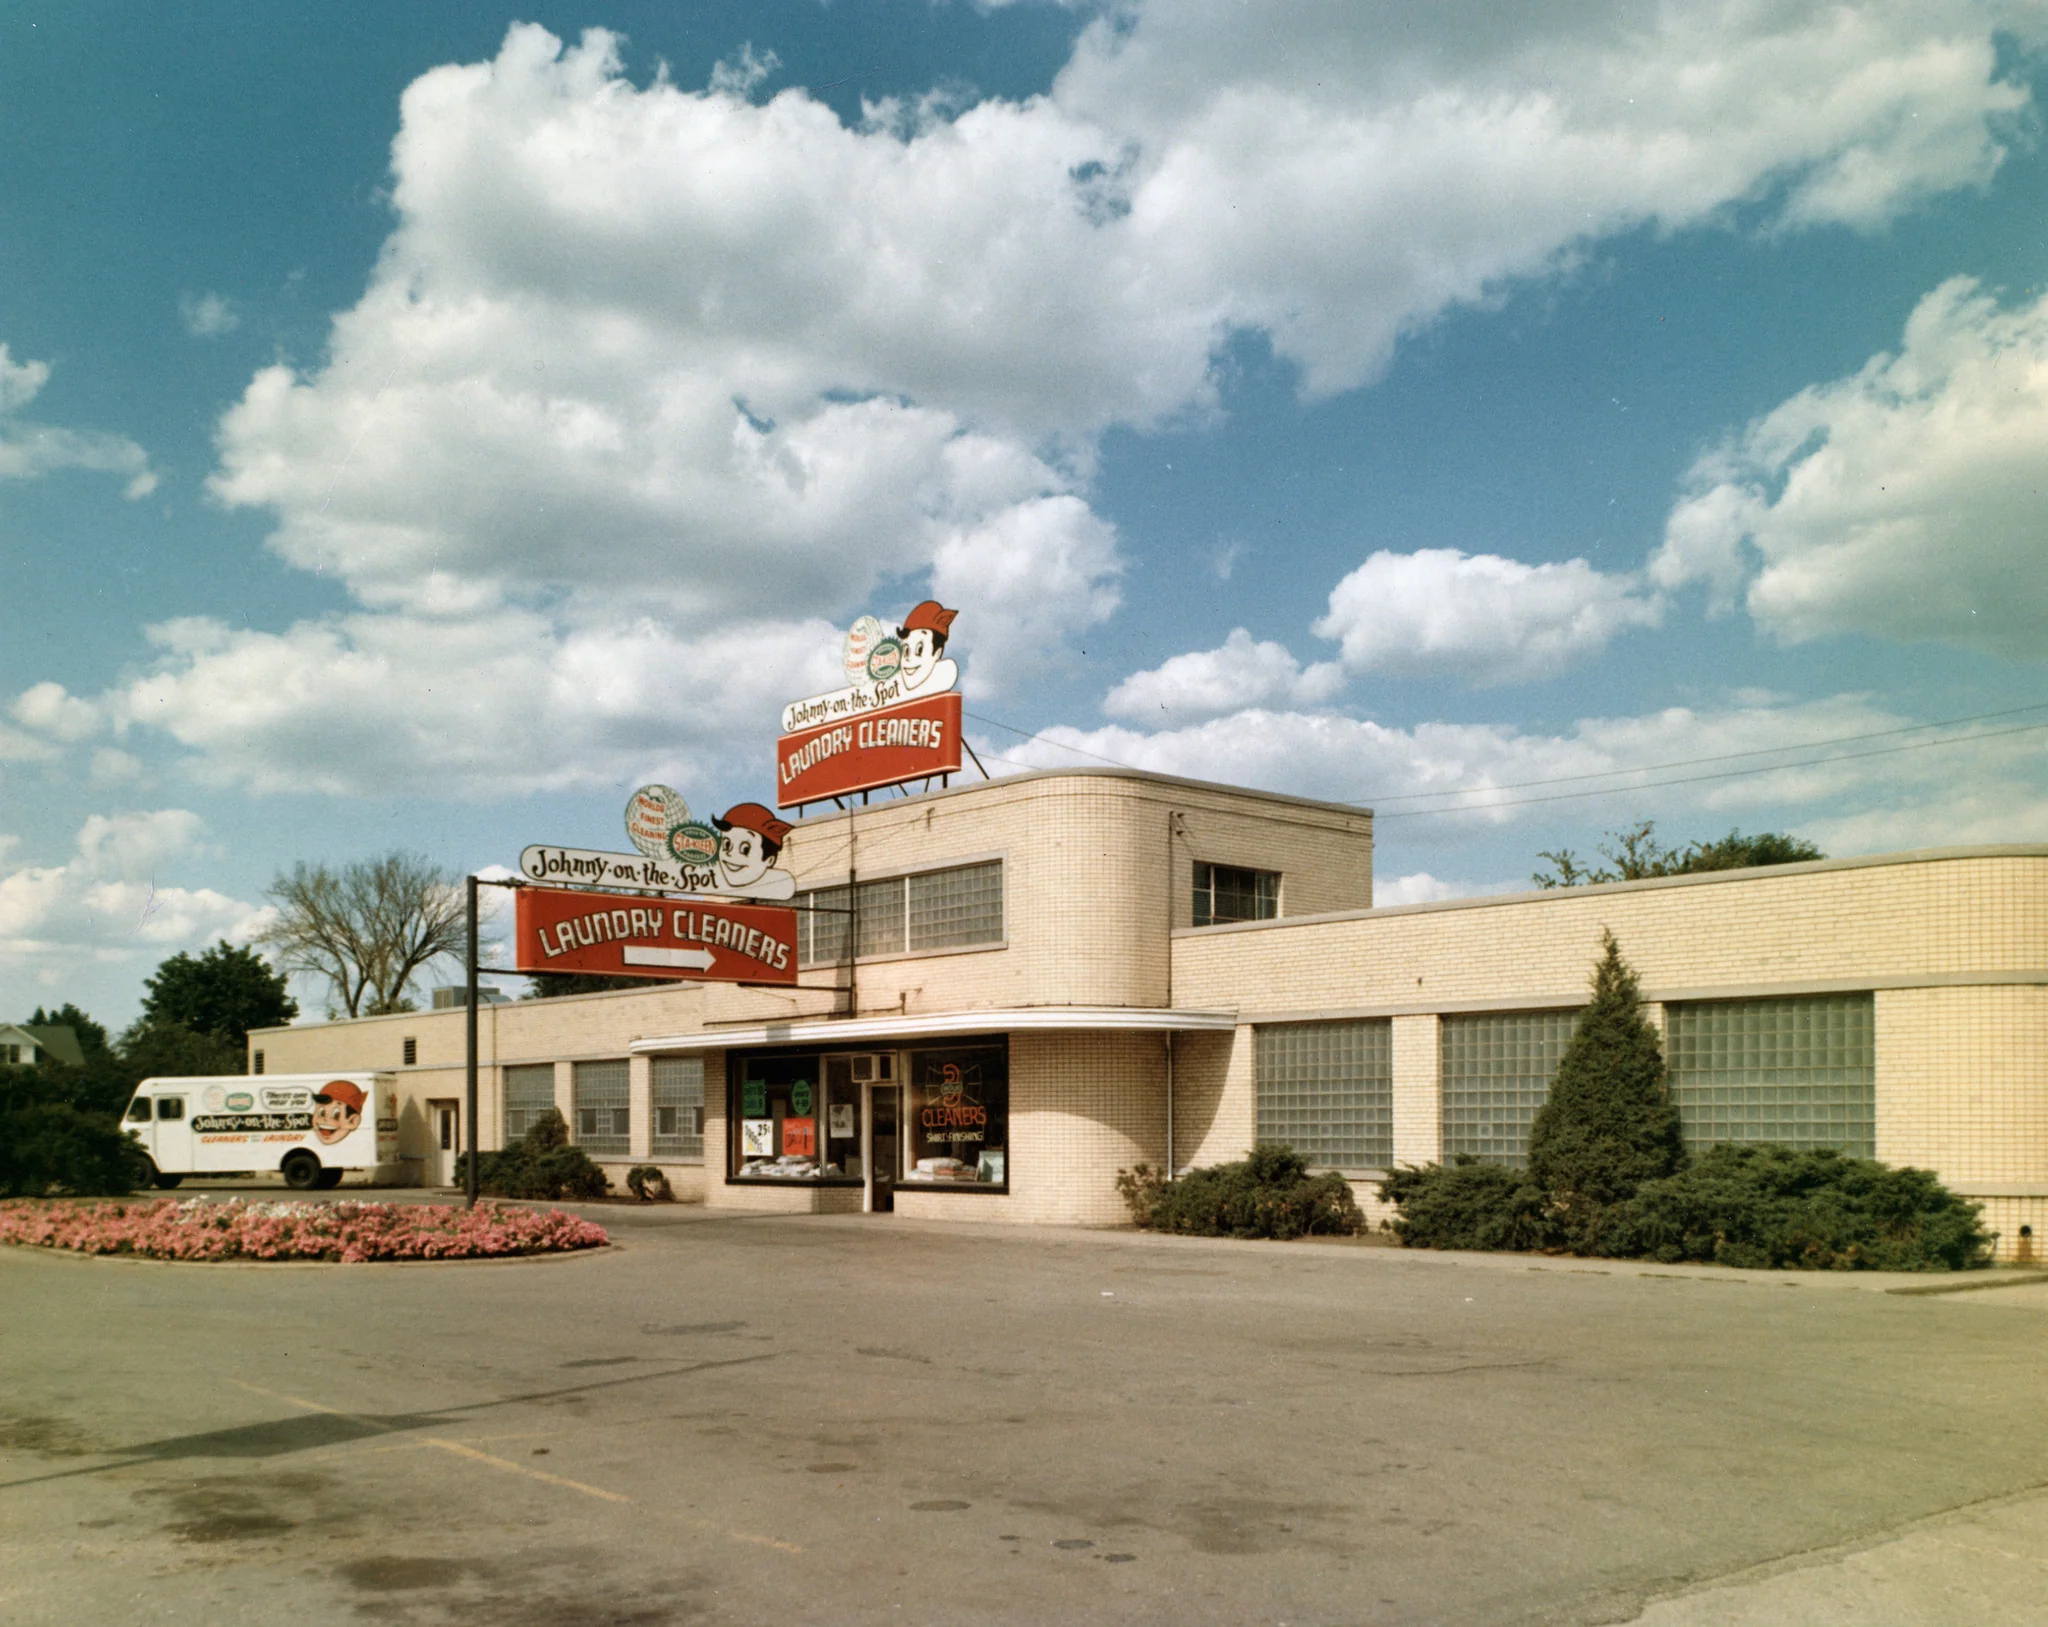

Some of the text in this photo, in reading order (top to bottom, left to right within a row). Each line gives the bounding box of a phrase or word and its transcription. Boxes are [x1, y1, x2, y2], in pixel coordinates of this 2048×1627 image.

[780, 718, 944, 785] LAUNDRY CLEANERS
[641, 812, 664, 826] FINEST
[632, 822, 667, 840] CLEANING
[538, 908, 791, 971] LAUNDRY CLEANERS
[922, 1106, 987, 1128] CLEANERS
[201, 1134, 306, 1143] CLEANERS LAUNDRY
[926, 1132, 946, 1143] SHIRT
